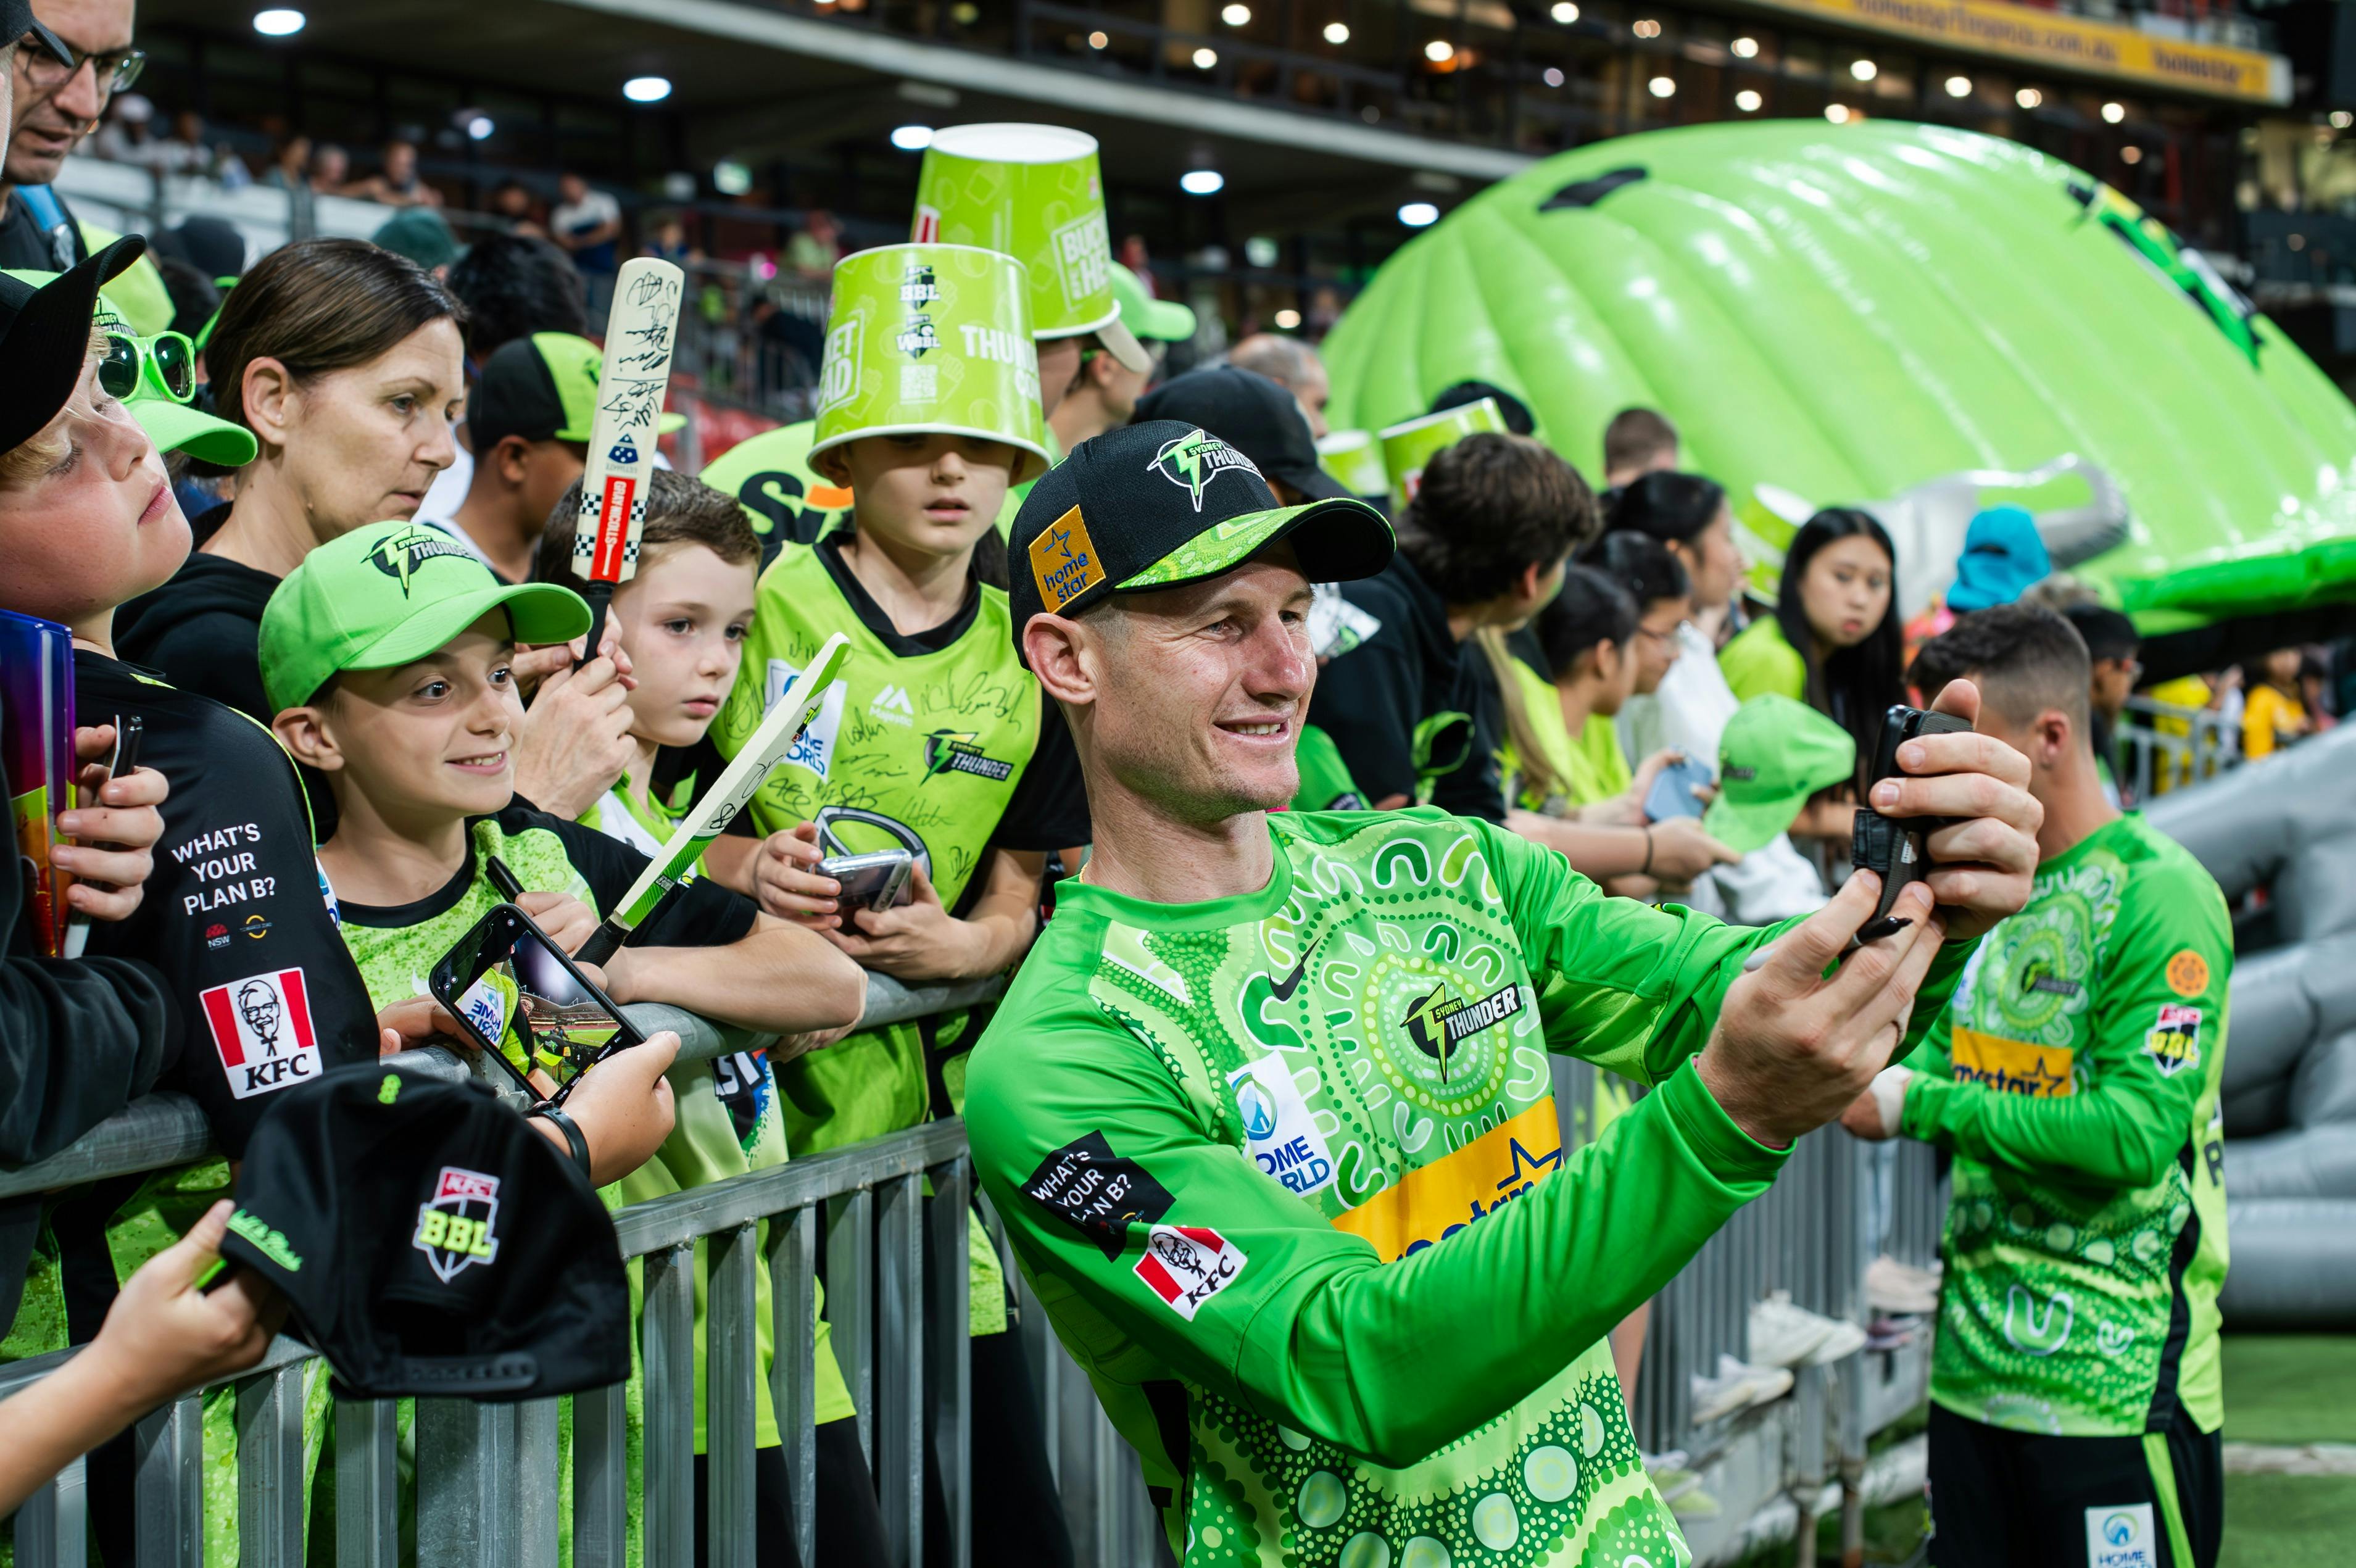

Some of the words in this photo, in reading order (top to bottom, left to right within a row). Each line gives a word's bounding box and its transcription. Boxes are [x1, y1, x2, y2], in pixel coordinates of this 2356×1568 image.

[899, 284, 941, 301] BBL
[1188, 442, 1224, 456] SYDNEY
[1202, 449, 1260, 473] THUNDE
[397, 535, 432, 549] SYDNEY
[1043, 552, 1089, 592] home
[1057, 571, 1088, 603] star
[951, 752, 1012, 780] THUNDER
[171, 823, 261, 863] WHAT'S
[190, 852, 257, 882] YOUR
[183, 882, 248, 916] PLAN
[250, 877, 275, 898] B?
[207, 935, 230, 948] NSW
[1435, 999, 1462, 1019] SYDNEY
[1445, 987, 1518, 1040] THUNDER
[246, 1053, 309, 1091] KFC
[571, 1076, 581, 1087] VIDEO
[1255, 1135, 1314, 1176] OME
[445, 1174, 487, 1196] KFC
[1031, 1151, 1091, 1201] WHAT'S
[1056, 1168, 1105, 1208] YOUR
[1106, 1174, 1132, 1201] B?
[1279, 1158, 1330, 1193] RLD
[418, 1209, 492, 1257] BBL
[1185, 1254, 1235, 1309] KFC
